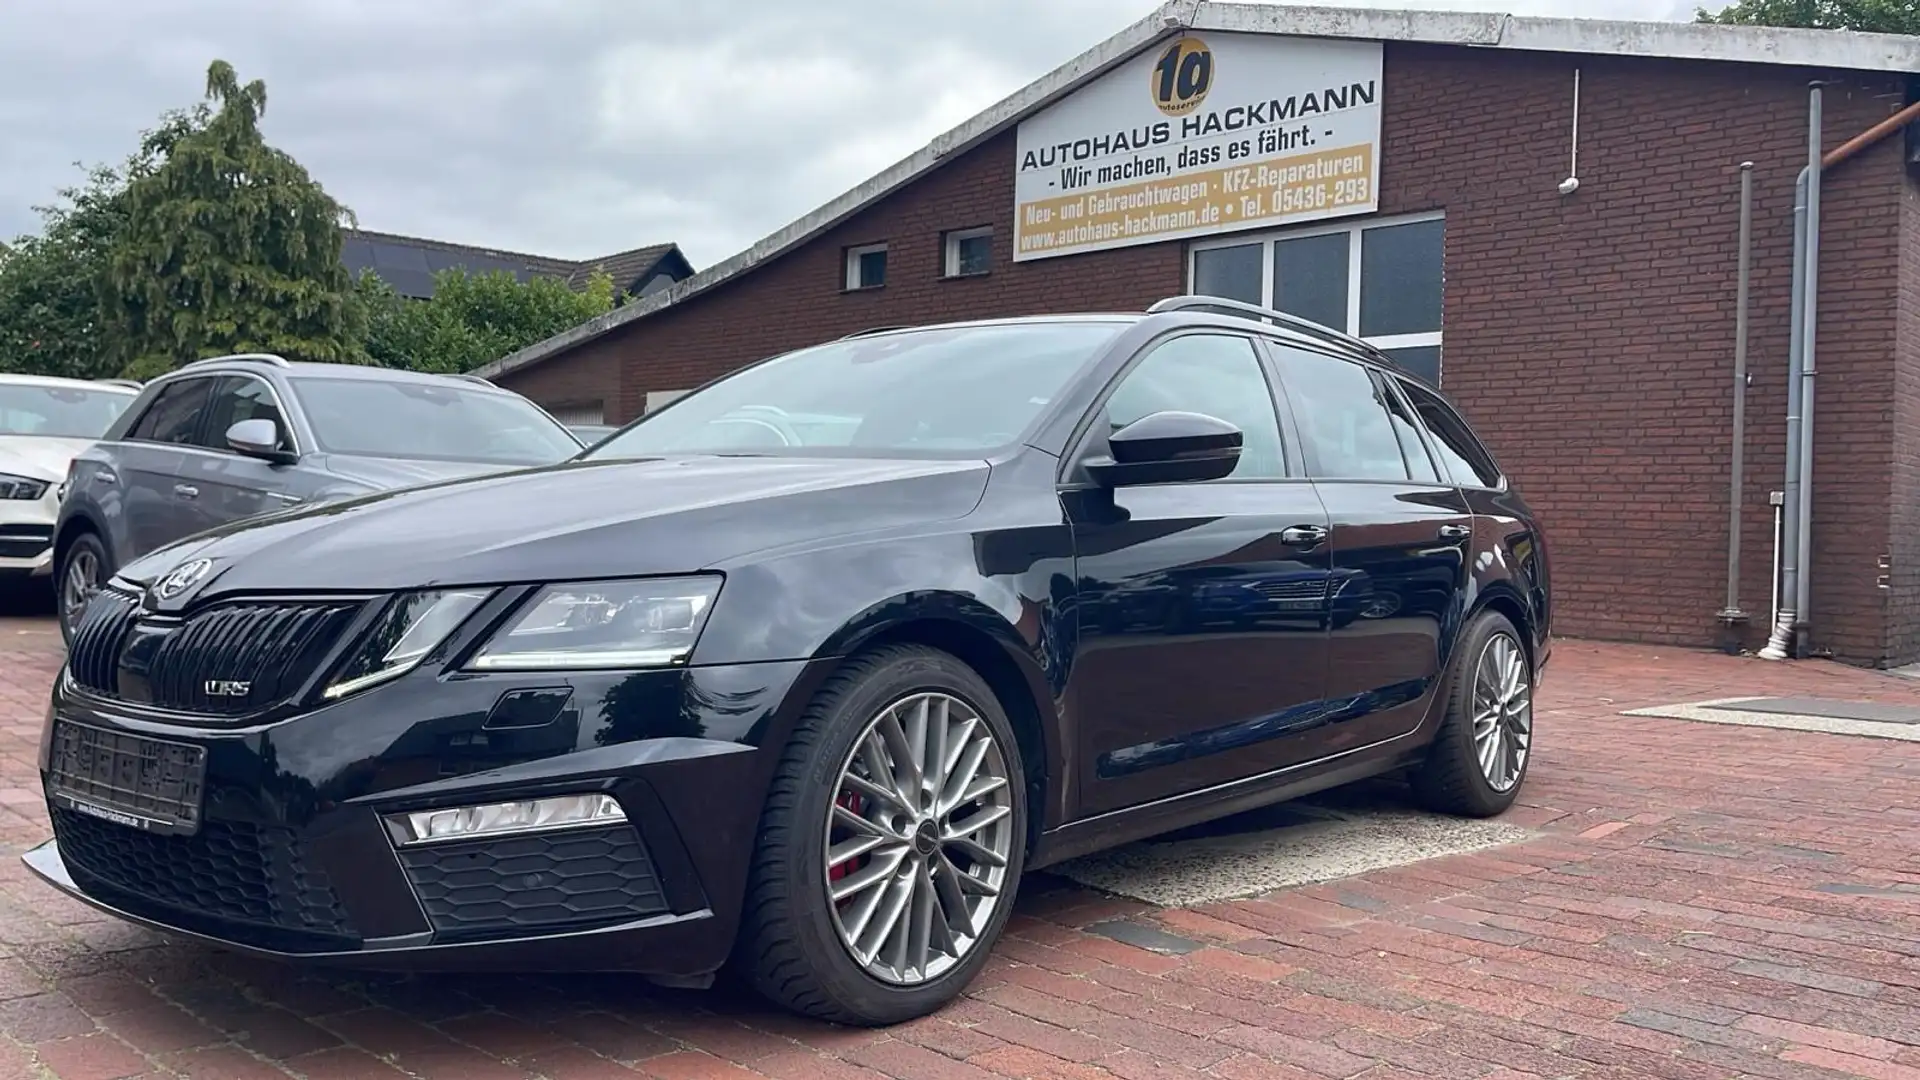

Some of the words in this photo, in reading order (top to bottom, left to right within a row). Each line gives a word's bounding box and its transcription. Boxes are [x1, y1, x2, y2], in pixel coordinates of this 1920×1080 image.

[1156, 44, 1211, 102] 1a
[1021, 123, 1170, 172] AUTOHAUS
[1182, 80, 1375, 138] HACKMANN
[1061, 166, 1092, 190] Wir
[1097, 155, 1171, 184] machen,
[1178, 145, 1220, 169] dass
[1228, 139, 1250, 160] es
[1258, 125, 1316, 155] fährt.
[1021, 202, 1219, 250] www.autohaus-hackmann.de
[1240, 193, 1266, 218] Tel.
[1272, 177, 1368, 214] 05436-293
[1026, 204, 1056, 226] Neu-
[1060, 197, 1084, 220] und
[1088, 181, 1208, 216] Gebrauchtwagen
[1223, 154, 1363, 193] KFZ-Reparaturen
